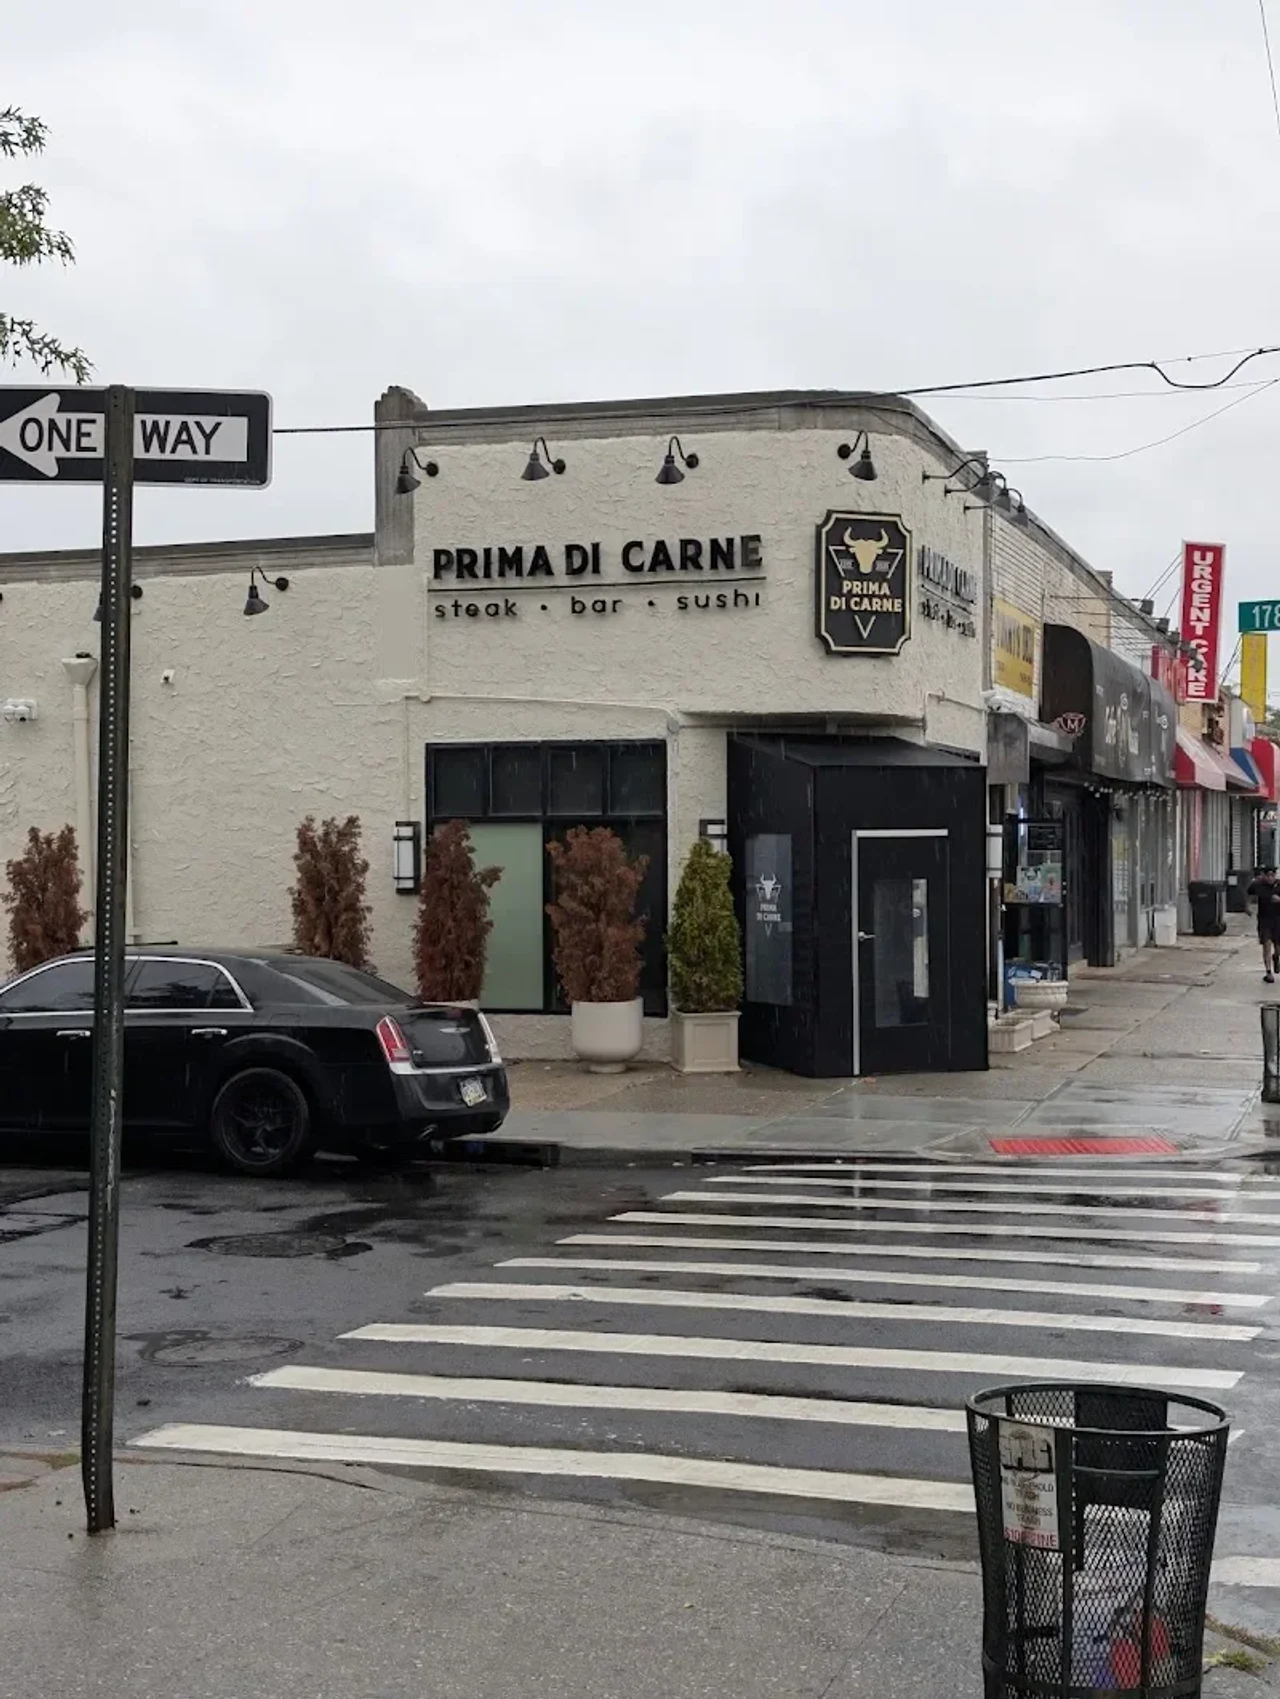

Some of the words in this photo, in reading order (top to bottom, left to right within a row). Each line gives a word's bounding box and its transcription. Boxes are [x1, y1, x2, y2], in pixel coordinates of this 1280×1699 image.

[19, 417, 97, 452] ONE
[140, 419, 222, 455] WAY
[432, 545, 555, 580] PRIMA
[564, 541, 602, 576] DI
[620, 534, 763, 573] CARNE
[434, 597, 518, 618] steak
[570, 595, 624, 615] bar
[676, 588, 761, 611] sushi
[830, 595, 847, 611] DI
[850, 597, 903, 613] CARNE
[843, 580, 891, 595] PRIMA
[1190, 551, 1214, 635] URGENT
